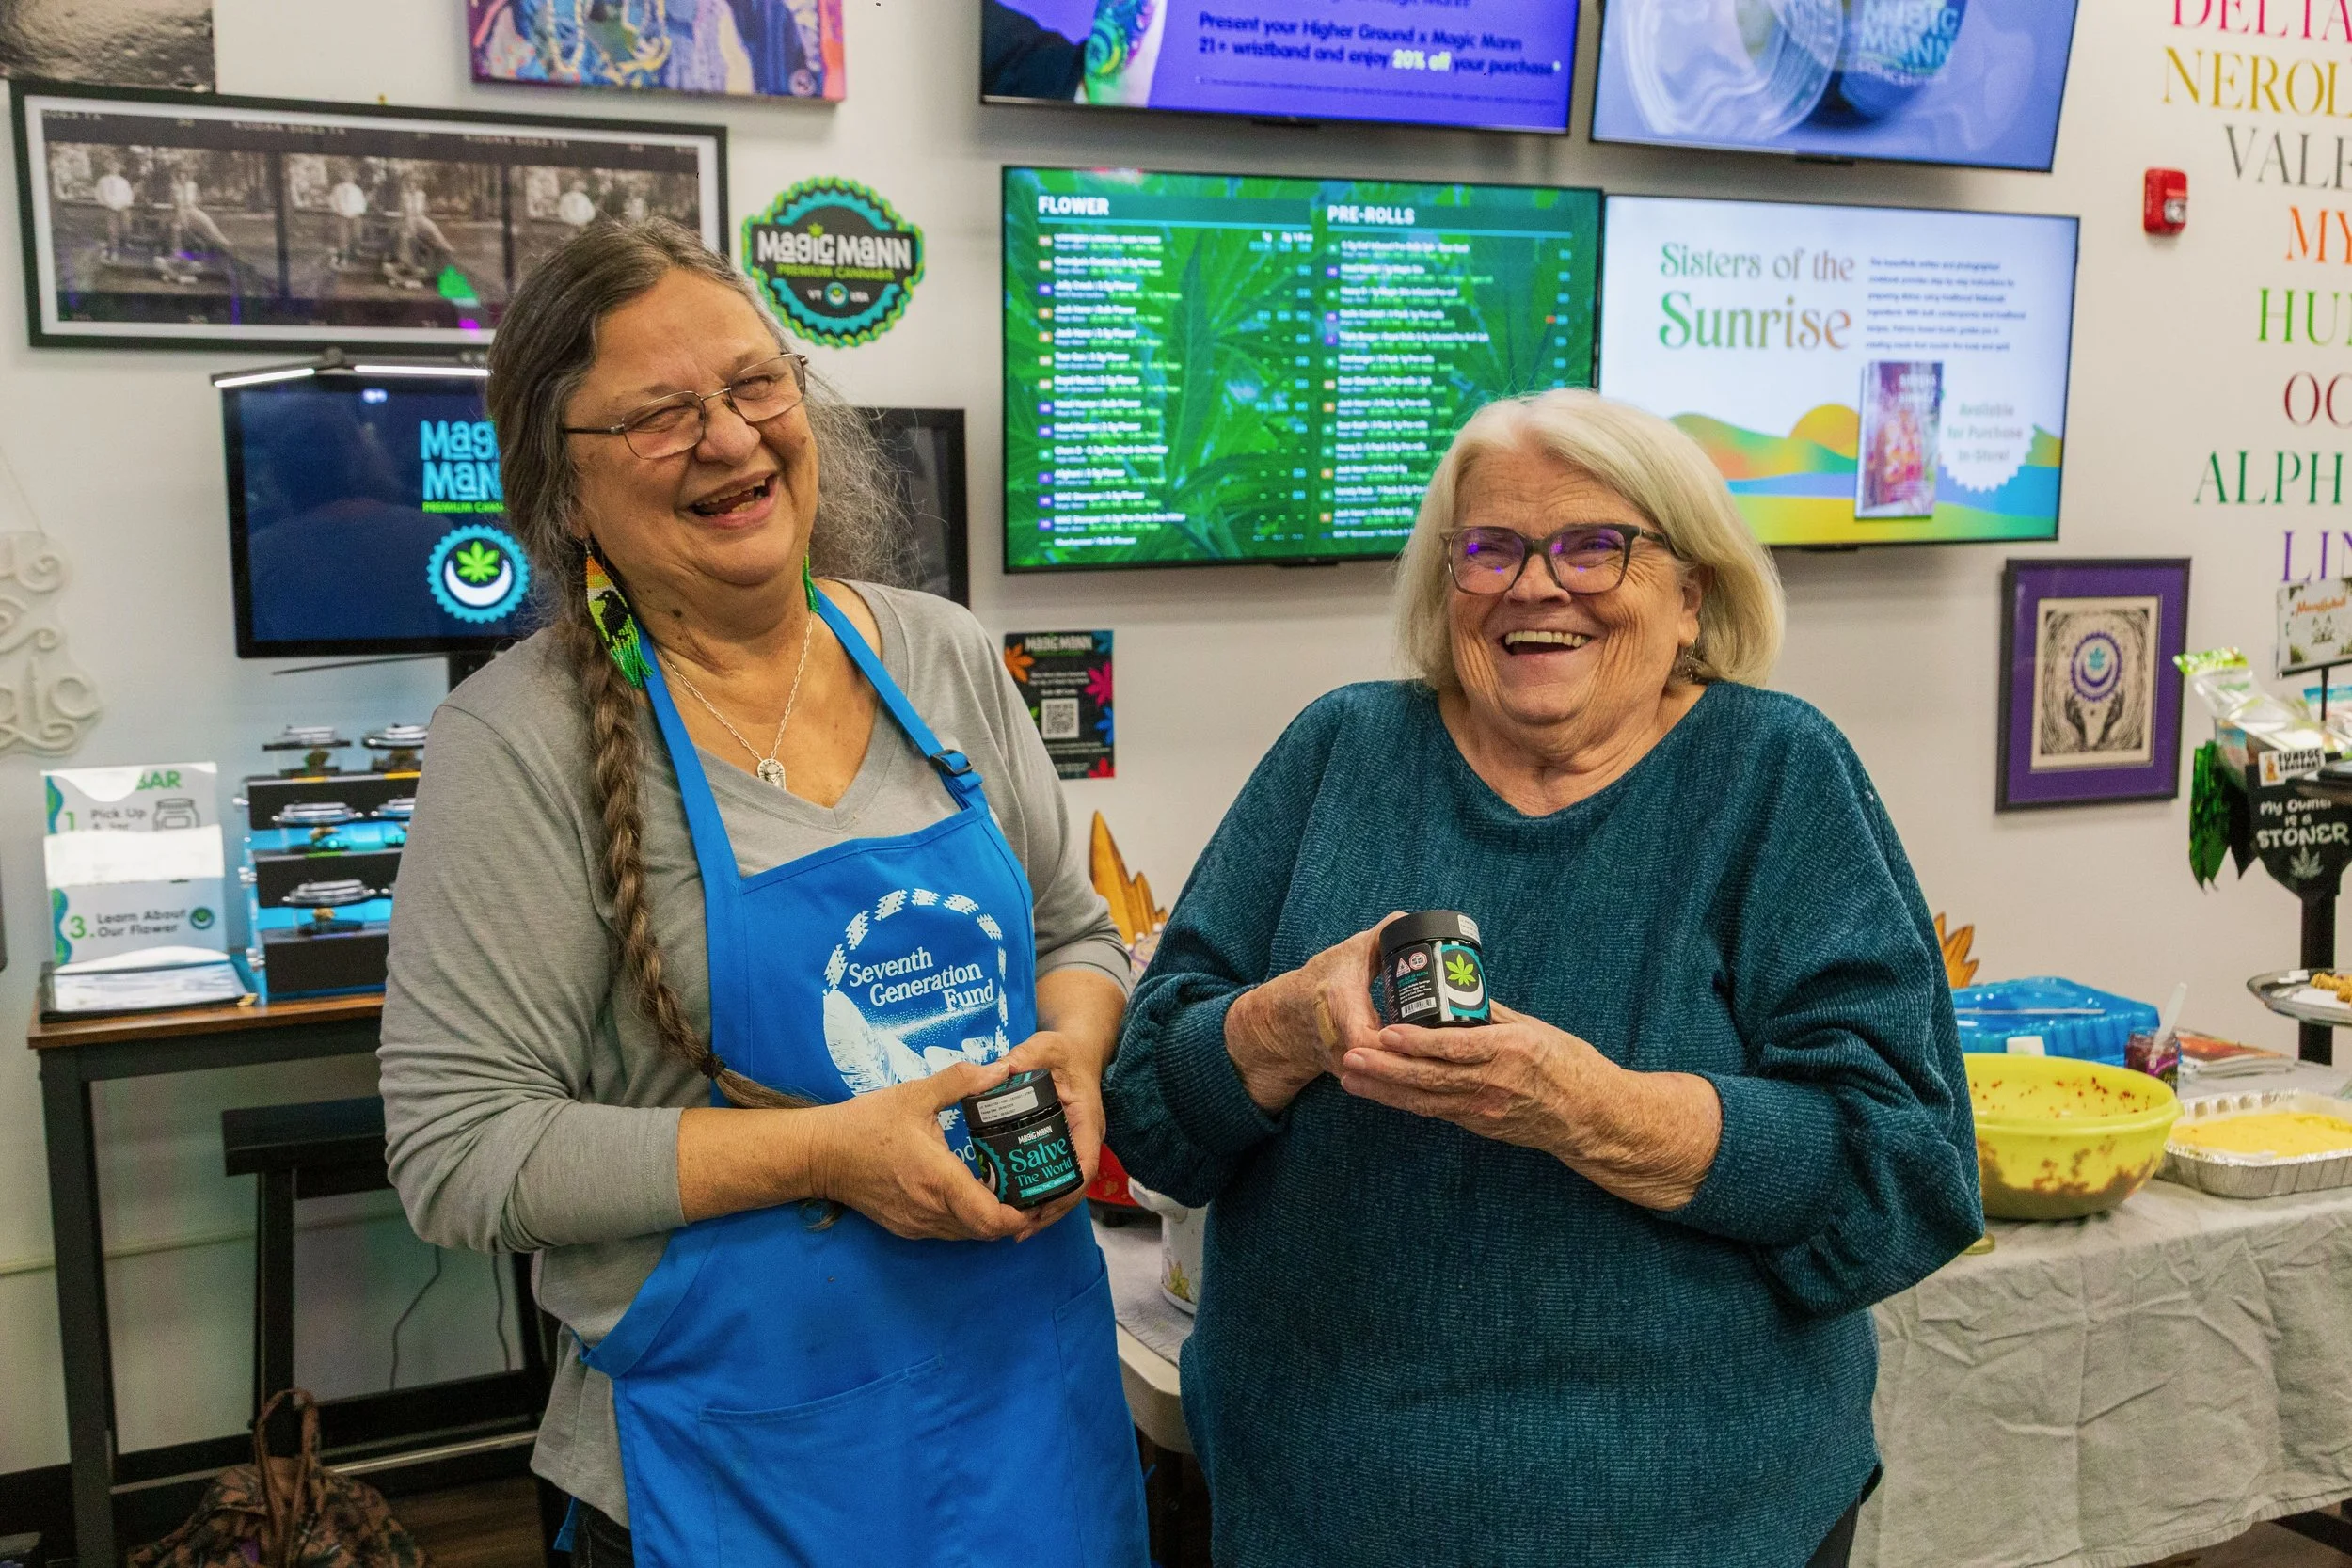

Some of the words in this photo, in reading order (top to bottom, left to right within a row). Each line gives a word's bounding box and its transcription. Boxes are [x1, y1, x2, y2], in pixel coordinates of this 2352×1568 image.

[1302, 19, 1353, 40] Higher
[1359, 23, 1414, 42] Ground
[1432, 29, 1475, 51] Magic
[1232, 40, 1311, 60] wristband
[1314, 46, 1343, 62] and
[1349, 50, 1389, 69] enjoy
[1038, 196, 1109, 215] FLOWER
[1327, 205, 1415, 225] PRE-ROLLS
[1661, 242, 1762, 280] Sisters
[1773, 248, 1804, 279] of
[1812, 249, 1855, 281] the
[1660, 290, 1851, 351] Sunrise
[2257, 288, 2352, 346] HU
[2193, 450, 2344, 506] ALPH
[90, 809, 119, 820] Pick
[125, 808, 147, 820] Up
[2256, 822, 2350, 848] STONER
[97, 912, 138, 925] Learn
[144, 909, 187, 921] About
[98, 926, 124, 938] Our
[130, 924, 179, 935] Flower
[849, 946, 933, 987] Seventh
[869, 962, 984, 1006] Generation
[943, 979, 994, 1011] Fund
[1009, 1138, 1069, 1173] Salve
[1015, 1173, 1040, 1186] The
[1041, 1156, 1073, 1178] World
